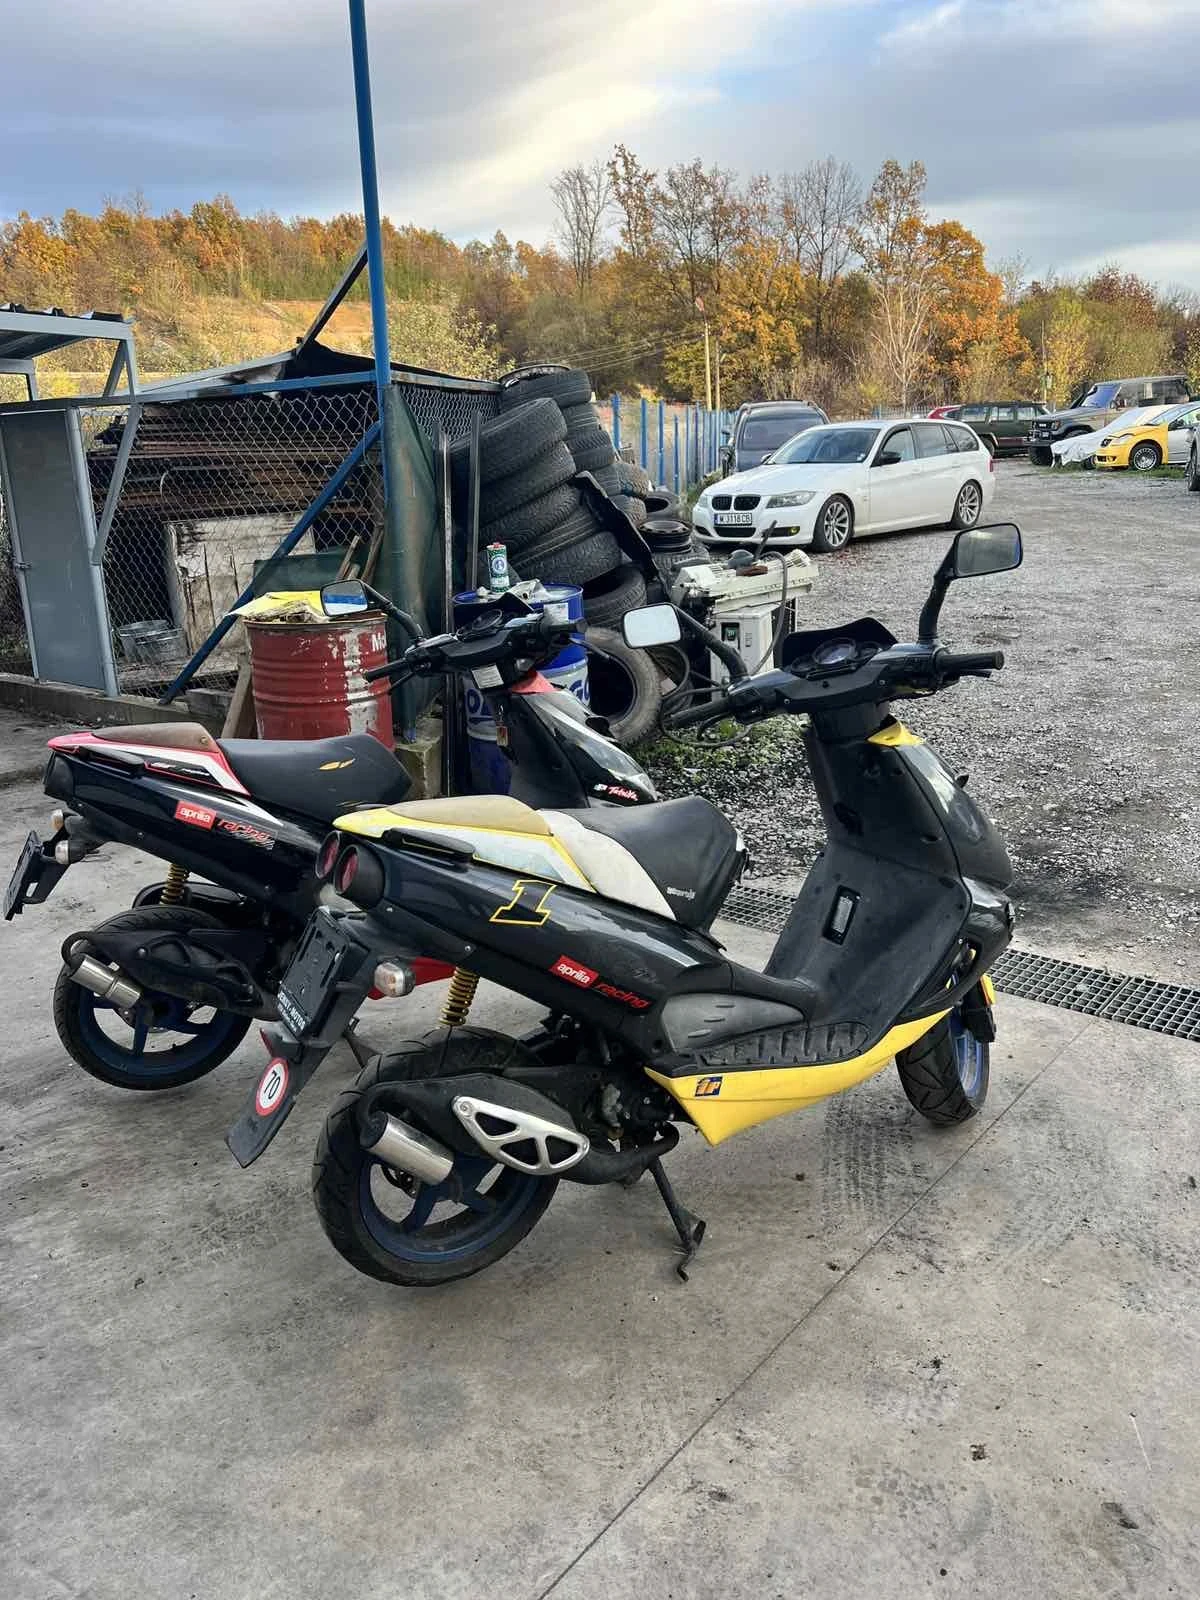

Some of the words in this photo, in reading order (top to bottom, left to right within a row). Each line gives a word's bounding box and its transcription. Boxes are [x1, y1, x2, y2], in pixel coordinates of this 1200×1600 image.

[180, 807, 211, 823] aprilia
[489, 880, 557, 926] 1
[557, 963, 591, 984] aprilia
[596, 983, 650, 1009] racing
[264, 1070, 281, 1100] 70
